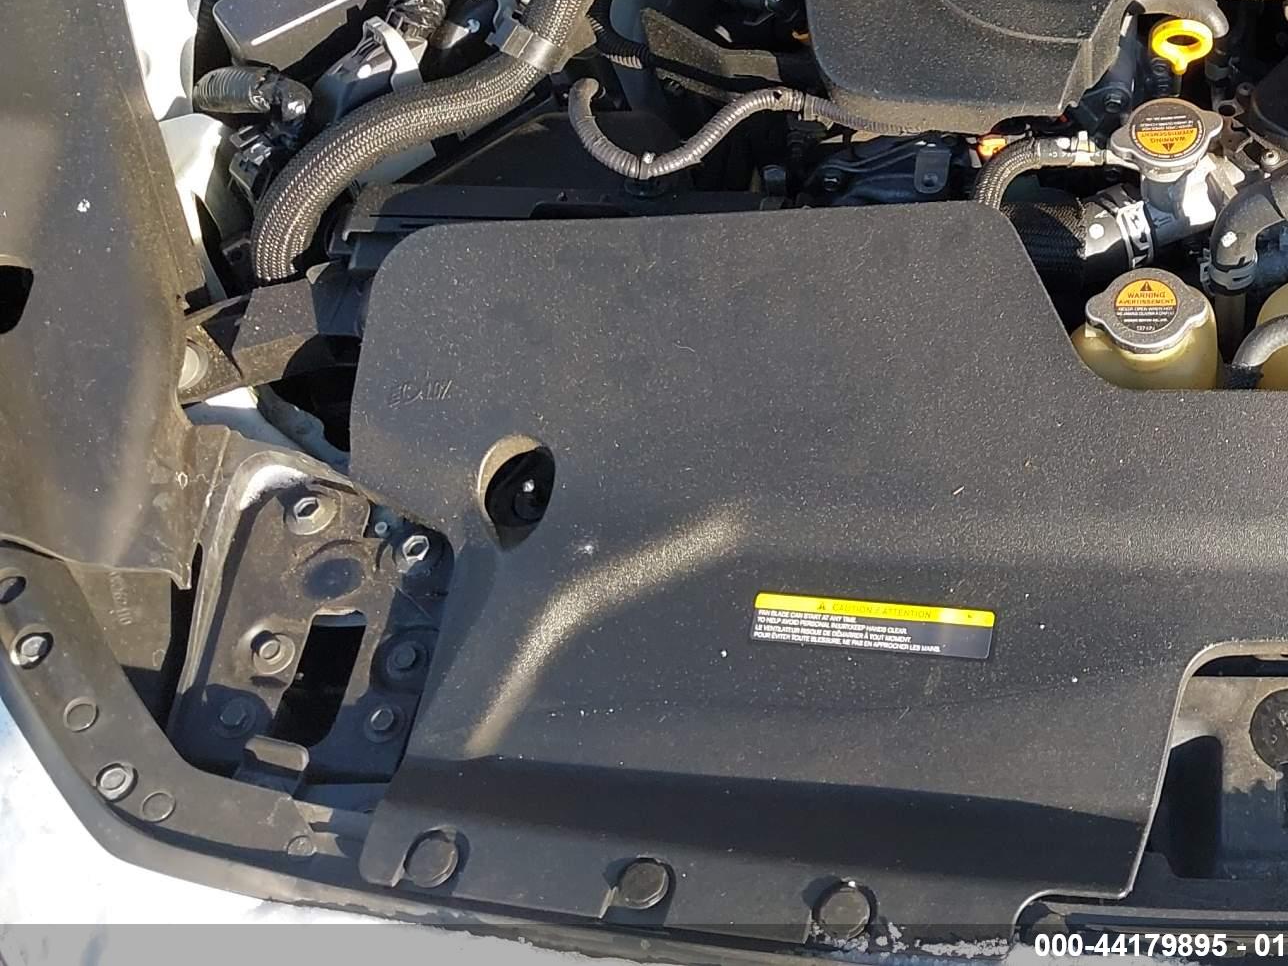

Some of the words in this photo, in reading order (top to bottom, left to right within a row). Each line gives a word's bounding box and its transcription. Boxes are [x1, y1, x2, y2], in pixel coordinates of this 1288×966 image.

[1127, 291, 1166, 299] WARNING
[831, 603, 873, 614] CAUTION
[882, 607, 931, 619] ATTENTION
